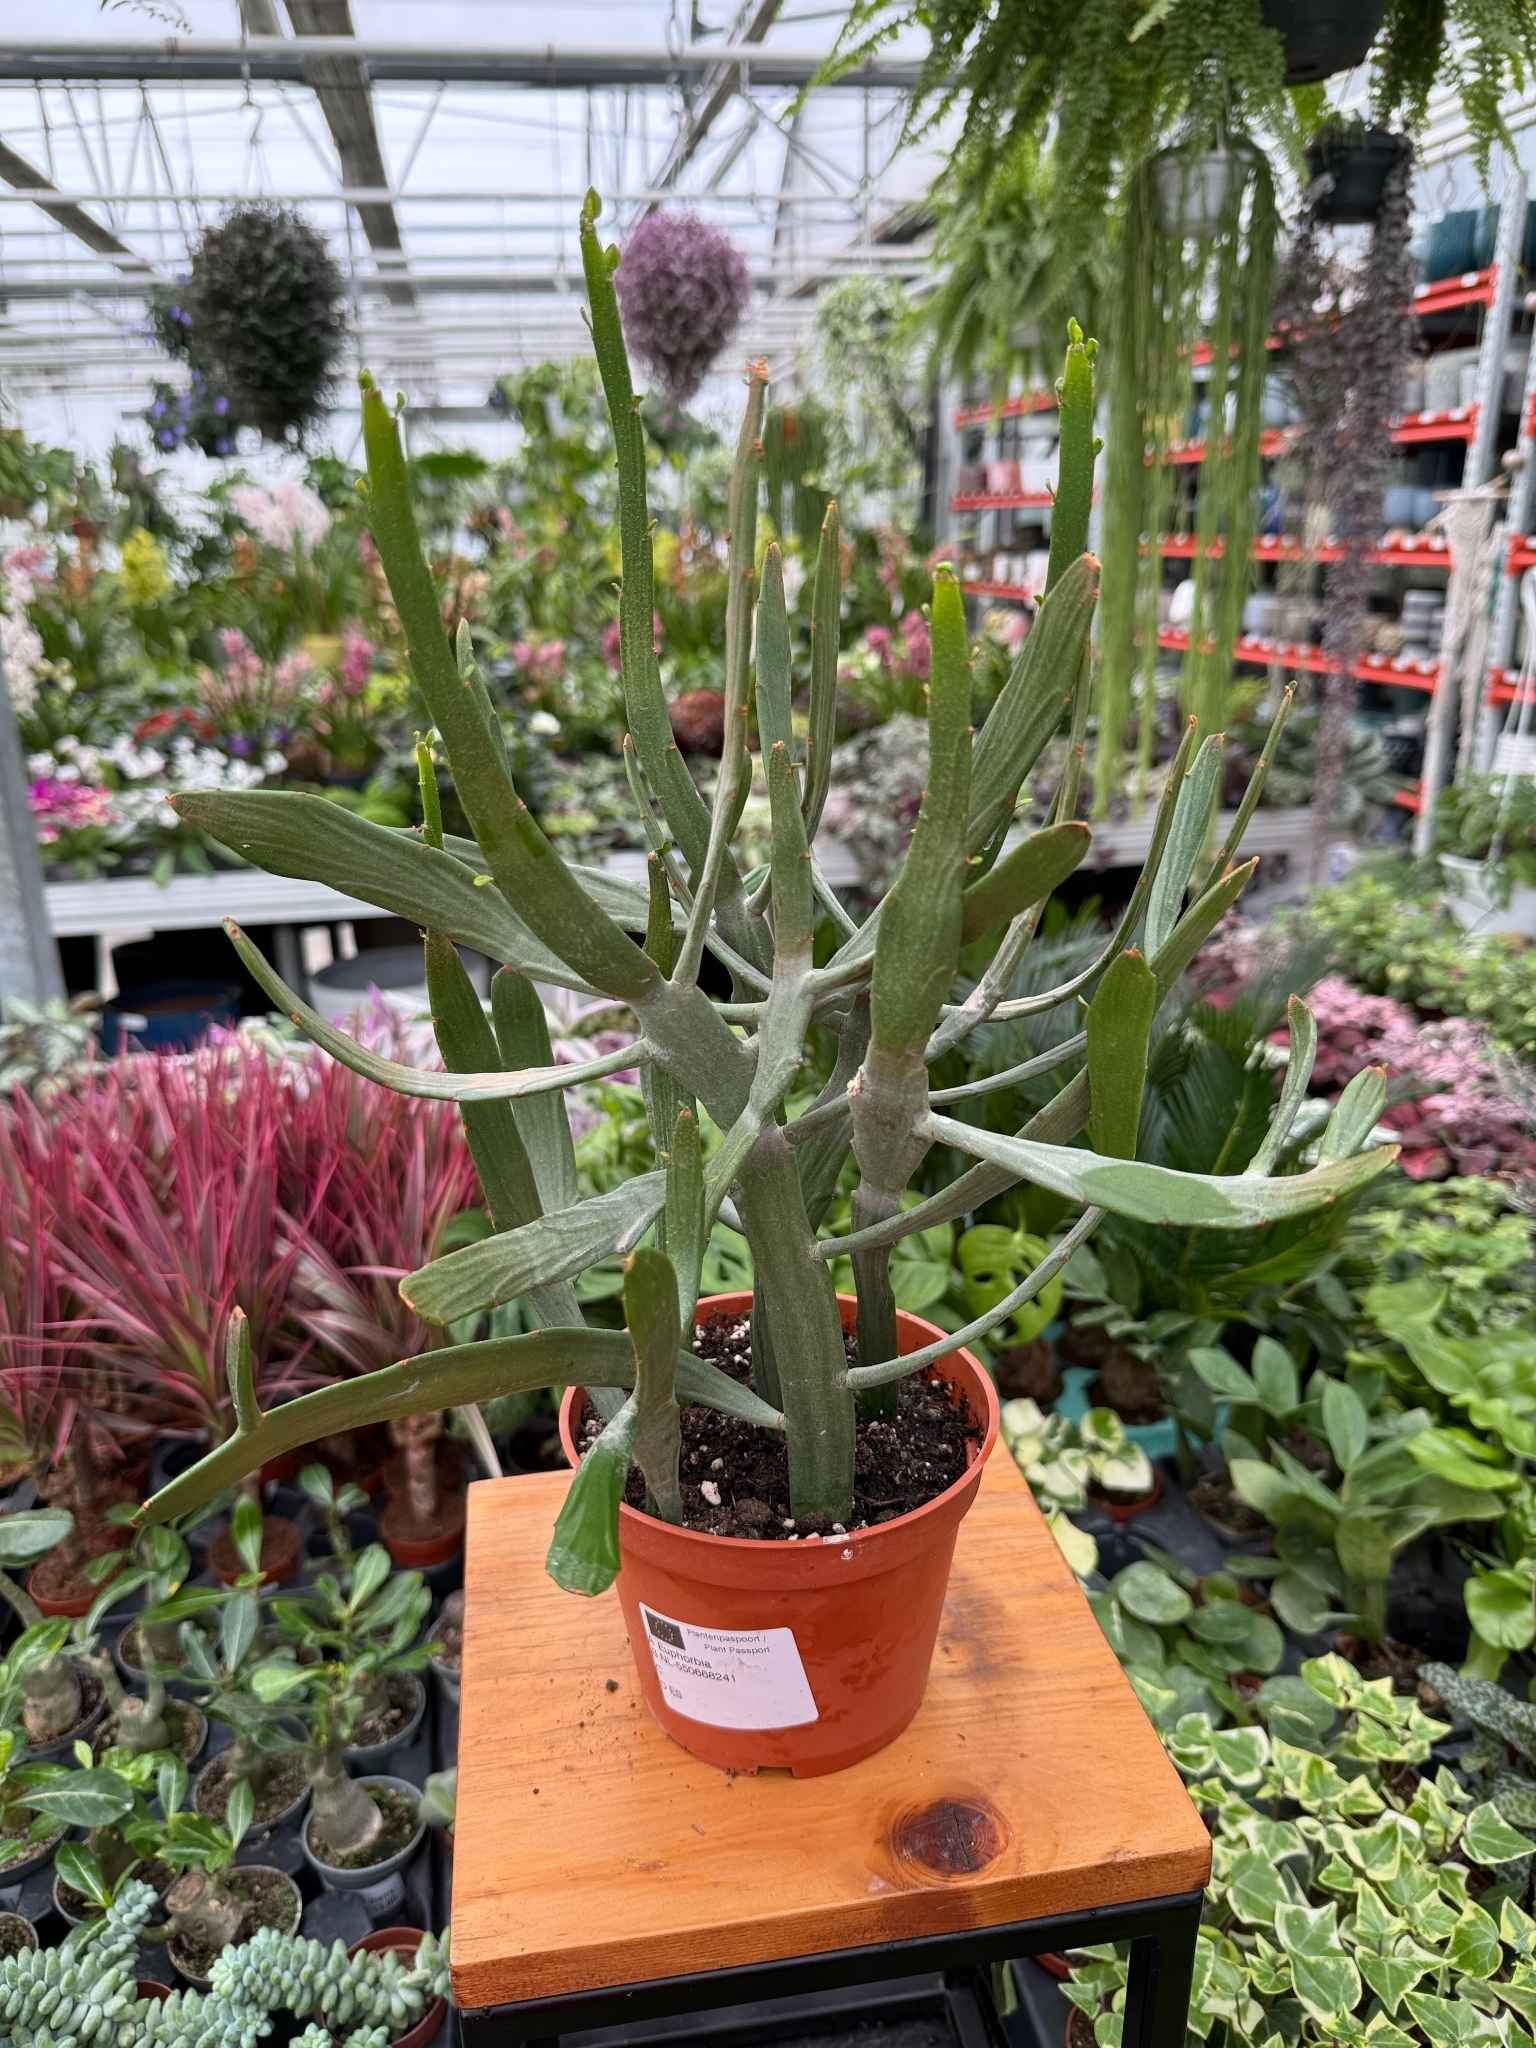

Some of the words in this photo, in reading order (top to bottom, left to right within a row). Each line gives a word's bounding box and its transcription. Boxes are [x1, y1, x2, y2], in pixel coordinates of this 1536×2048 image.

[657, 1640, 712, 1669] Euphorbia
[704, 1643, 727, 1653] Plant
[729, 1646, 770, 1656] Passport
